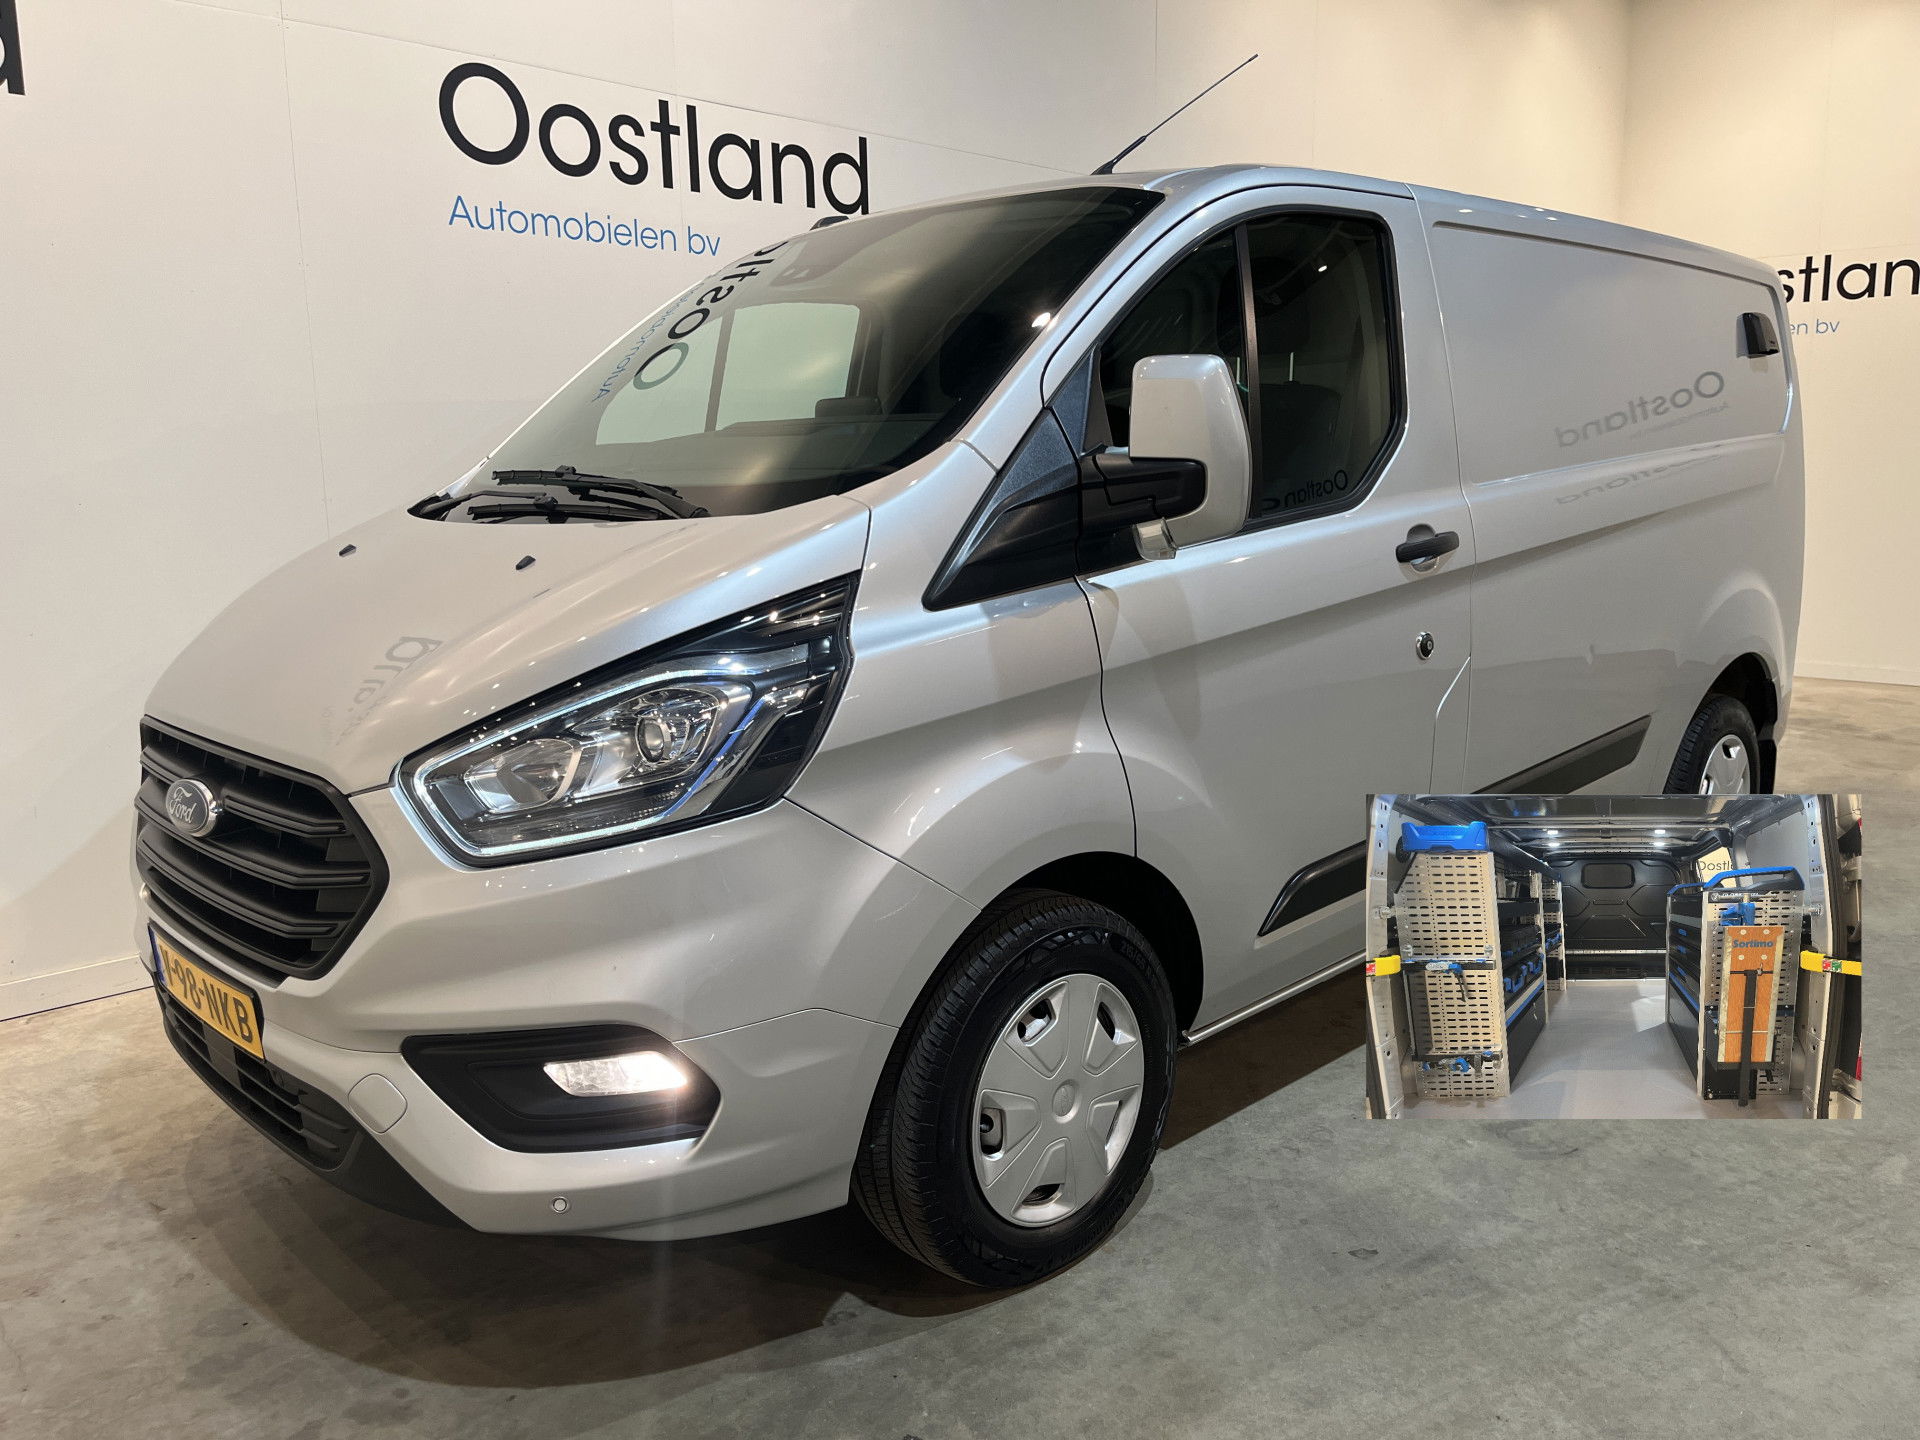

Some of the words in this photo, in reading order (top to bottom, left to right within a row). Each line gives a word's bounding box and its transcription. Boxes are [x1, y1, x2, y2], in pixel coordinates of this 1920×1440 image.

[439, 62, 869, 215] Oostland
[449, 195, 677, 252] Automobielen
[687, 226, 721, 257] bv
[1816, 318, 1840, 334] bv
[170, 786, 197, 824] Ford
[1731, 938, 1774, 949] Sortimo
